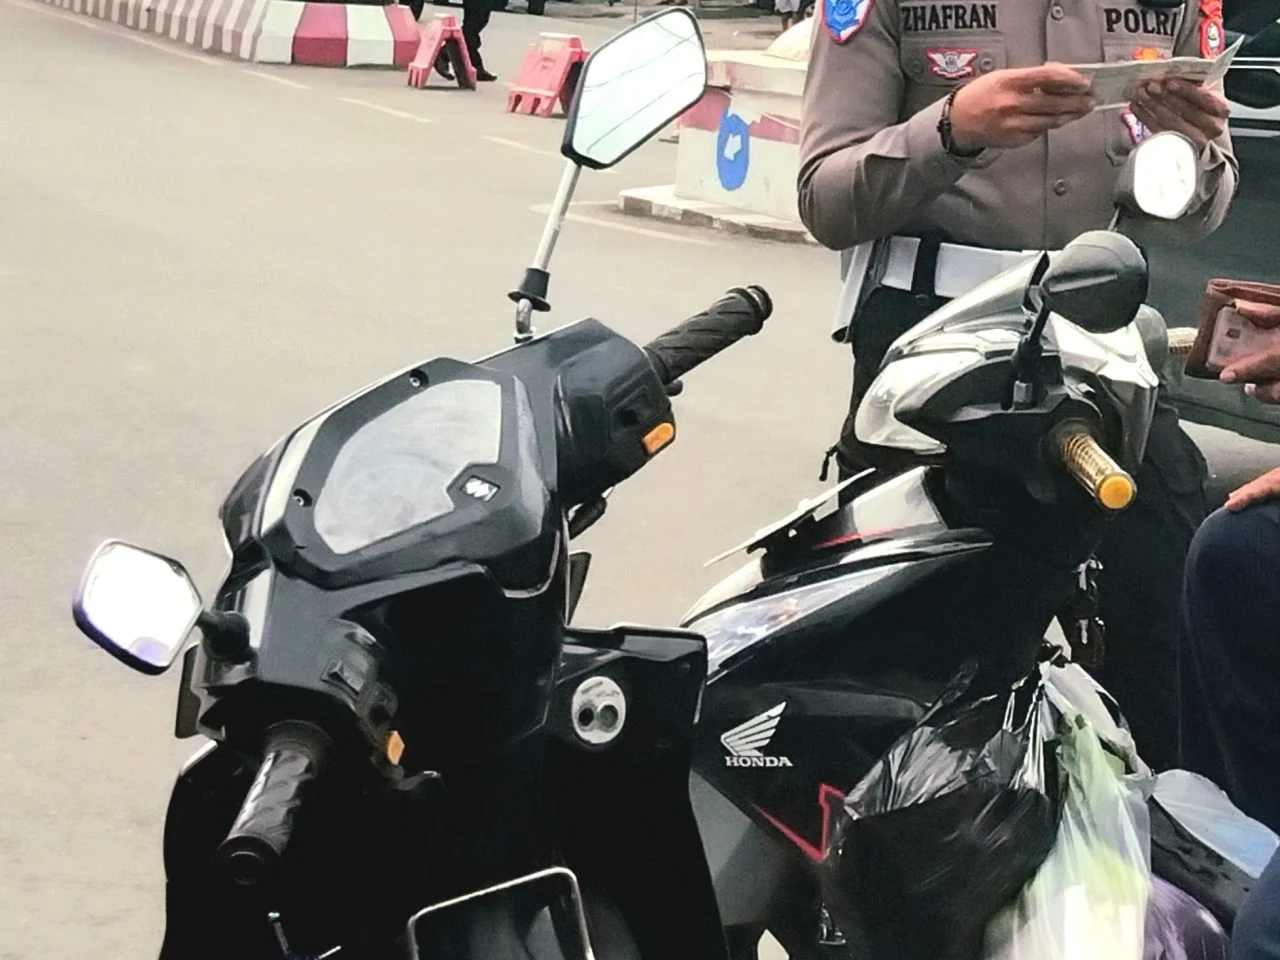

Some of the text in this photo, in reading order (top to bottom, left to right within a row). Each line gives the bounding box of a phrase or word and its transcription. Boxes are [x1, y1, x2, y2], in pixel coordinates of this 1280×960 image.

[901, 3, 997, 32] ZHAFRAN
[1103, 7, 1178, 37] POLRI
[724, 755, 794, 767] HONDA
